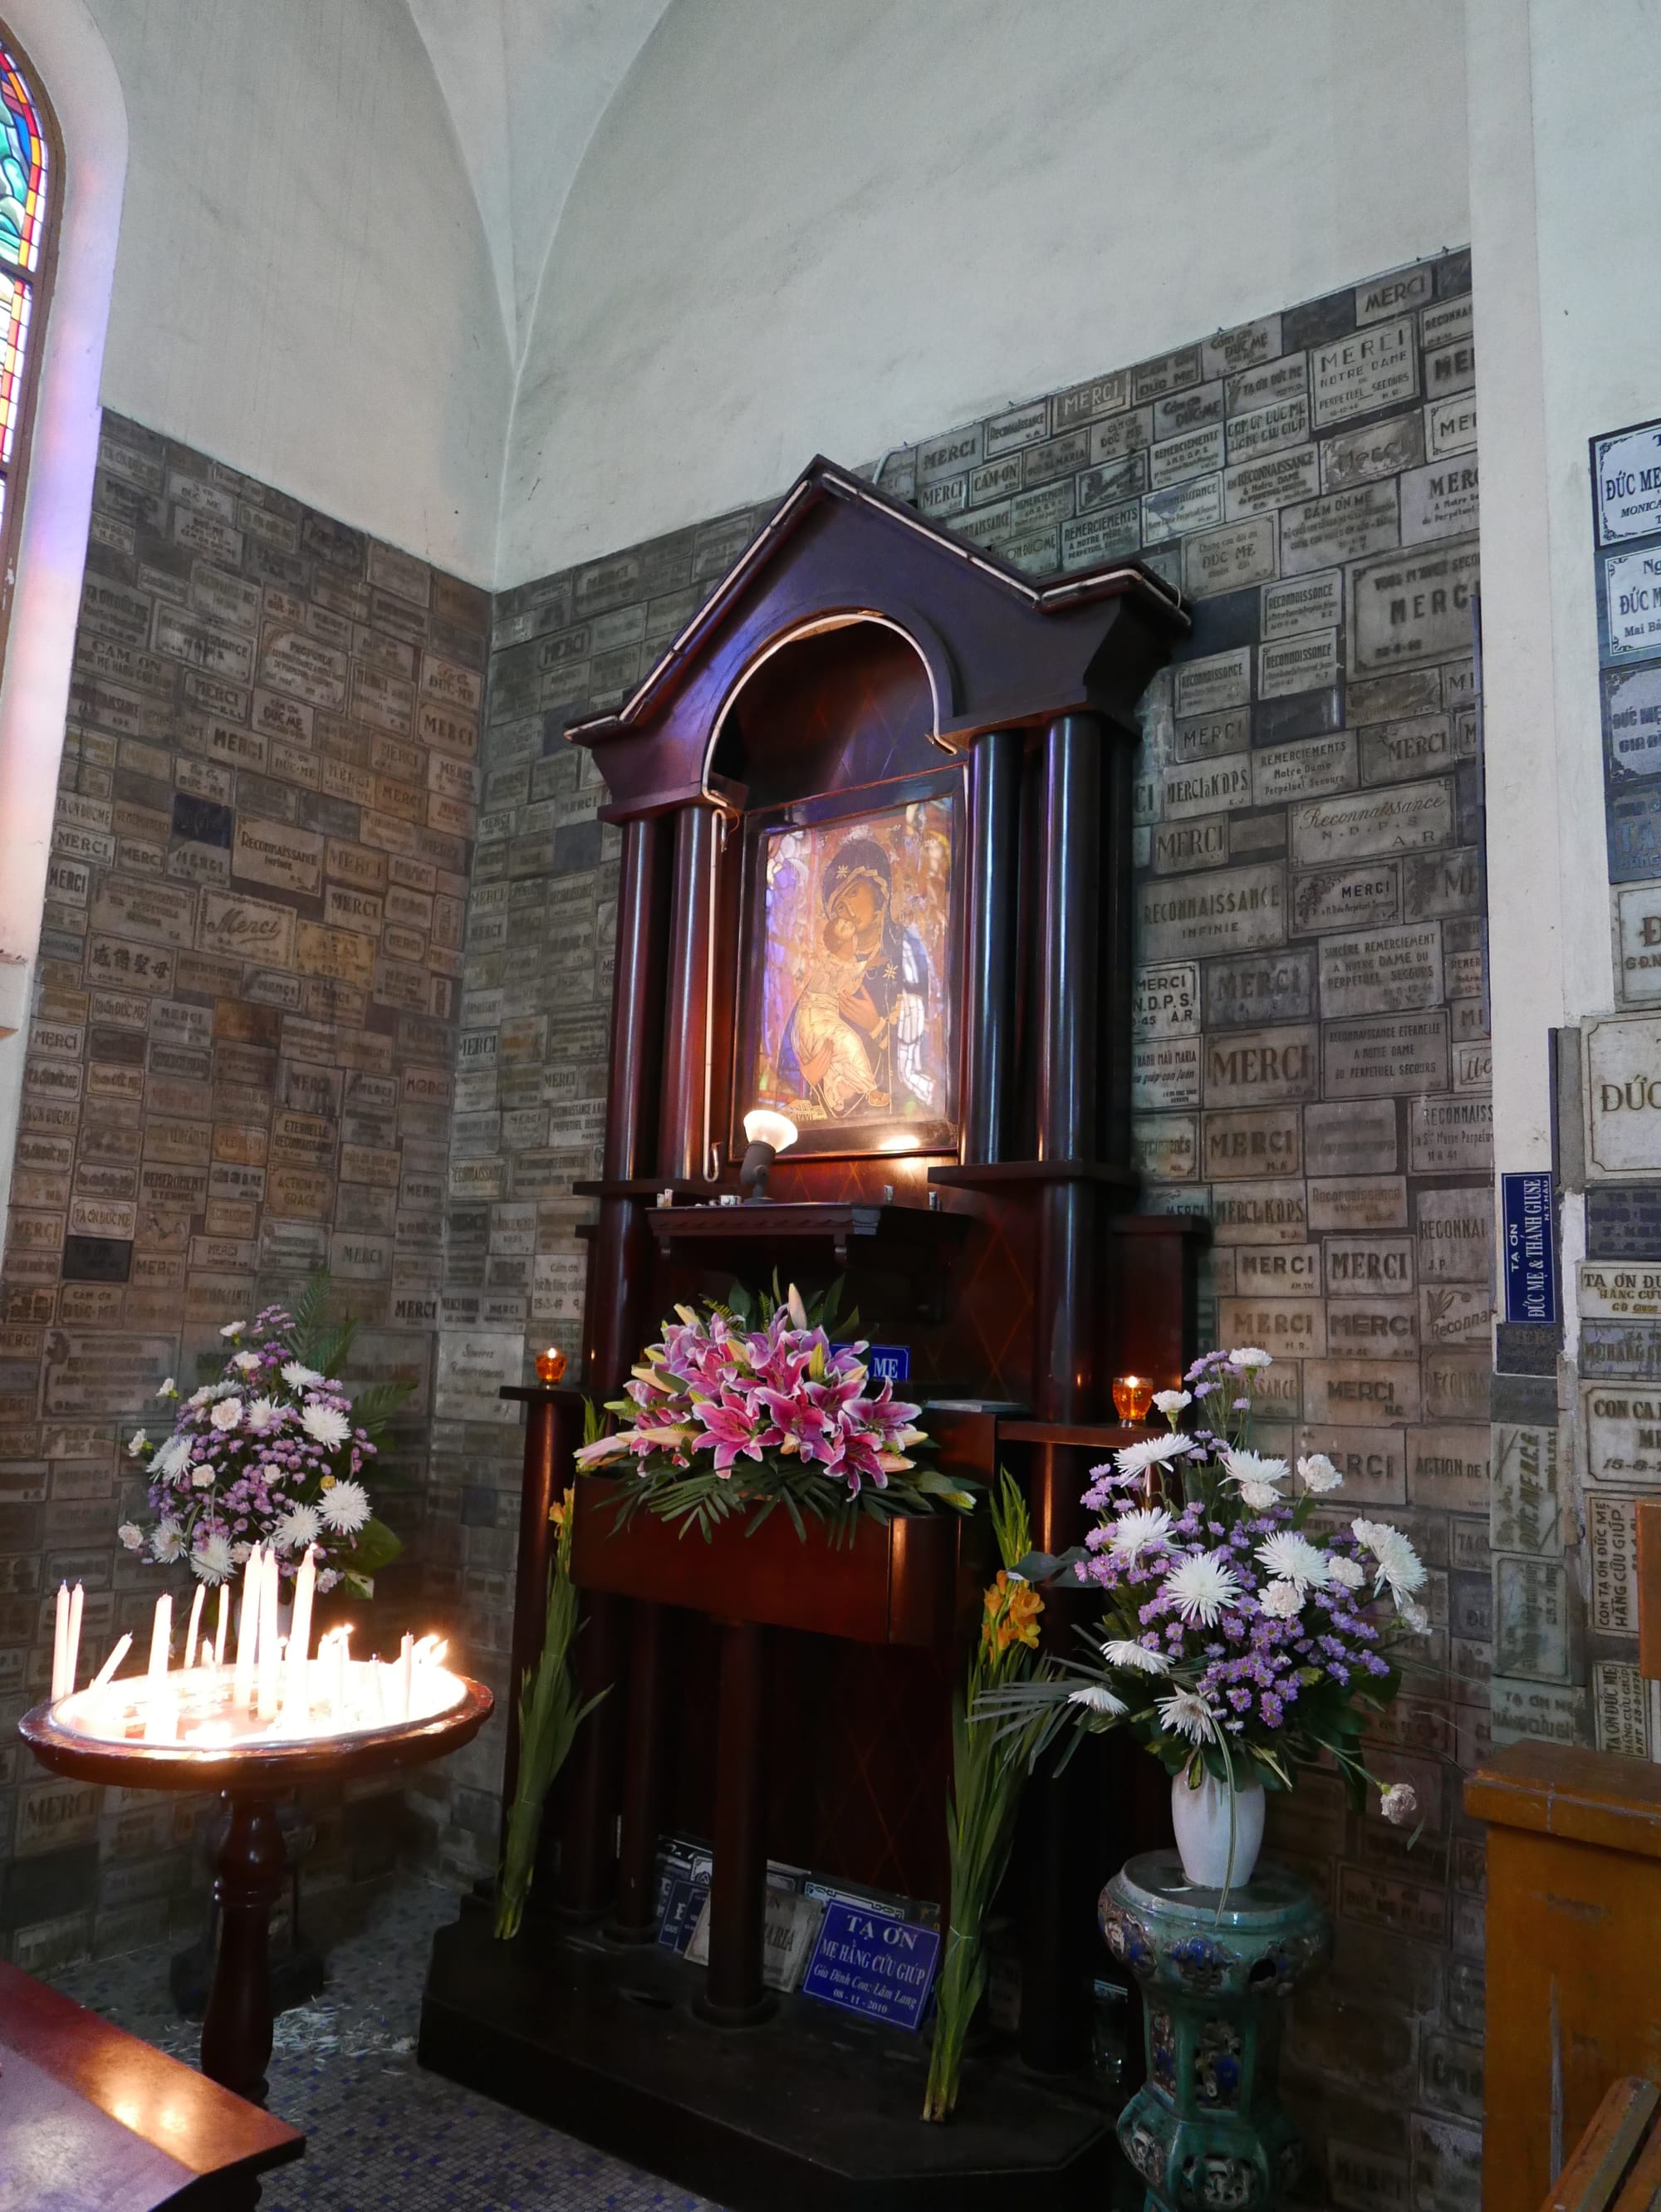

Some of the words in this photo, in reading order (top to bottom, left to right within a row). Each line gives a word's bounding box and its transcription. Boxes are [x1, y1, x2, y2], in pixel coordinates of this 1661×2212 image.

[1365, 276, 1425, 312] MERCI
[1320, 330, 1404, 373] MERCI
[1064, 380, 1119, 416] MERCI
[924, 439, 977, 471] MERCI
[923, 478, 963, 508] MERCI
[1605, 468, 1635, 502] ĐỨC
[1065, 508, 1138, 542] REMERCIEMENTS
[1267, 582, 1334, 611] RECONNAISSANCE
[1619, 586, 1649, 616] ĐỨC
[1267, 643, 1333, 670] RECONNAISSANCE
[1182, 663, 1243, 689] RECONNAISSANCE
[425, 714, 474, 746] MERCI
[1183, 720, 1243, 749] MERCI
[213, 728, 263, 761] MERCI
[1262, 740, 1346, 766] REMERCIEMENTS
[1389, 730, 1446, 762] MERCI
[1167, 777, 1203, 804] MERCI
[1300, 794, 1445, 831] Reconnaissance
[57, 831, 109, 857] MERCI
[120, 845, 164, 868] MERCI
[241, 831, 317, 866] RECONNAISSANCE
[1156, 825, 1223, 863] MERCI
[50, 866, 87, 894] MERCI
[1341, 881, 1390, 900] MERCI
[331, 892, 378, 919] MERCI
[1142, 885, 1280, 925] RECONNAISSANCE
[1182, 922, 1239, 939] INFINIE
[1365, 934, 1435, 953] REMERCIEMENT
[1379, 952, 1410, 967] DAME
[1136, 974, 1186, 992] MERCI
[35, 1029, 78, 1050] MERCI
[459, 1034, 497, 1057] MERCI
[1175, 1049, 1197, 1064] MARIA
[1213, 1044, 1310, 1086] MERCI
[1399, 1062, 1437, 1077] SECOURS
[544, 1071, 576, 1089] MERCI
[1212, 1130, 1293, 1158] MERCI
[1523, 1180, 1542, 1214] GIUSE
[1509, 1224, 1519, 1247] ƠN
[1520, 1216, 1543, 1258] THÁNH
[1242, 1255, 1313, 1275] MERCI
[1330, 1252, 1408, 1281] MERCI
[1511, 1251, 1521, 1273] TẠ
[1529, 1260, 1544, 1269] &
[1526, 1271, 1548, 1292] MẸ
[394, 1299, 437, 1321] MERCI
[1521, 1294, 1546, 1317] ĐỨC
[1233, 1312, 1313, 1335] MERCI
[1330, 1314, 1416, 1337] MERCI
[1327, 1380, 1394, 1403] MERCI
[1594, 1399, 1629, 1420] CON
[1415, 1457, 1462, 1477] ACTION
[1595, 1502, 1610, 1525] MẸ
[1594, 1528, 1608, 1557] ĐỨC
[1597, 1601, 1610, 1626] CON
[846, 1914, 875, 1940] TẠ
[883, 1925, 919, 1951] ƠN
[820, 1938, 839, 1961] MẸ
[839, 1939, 871, 1969] HẰNG
[872, 1954, 897, 1978] CỨU
[896, 1962, 926, 1986] GIÚP
[813, 1963, 829, 1979] Gia
[829, 1969, 851, 1988] Đình
[873, 1983, 893, 2000] Lâm
[866, 1999, 889, 2014] 2010
